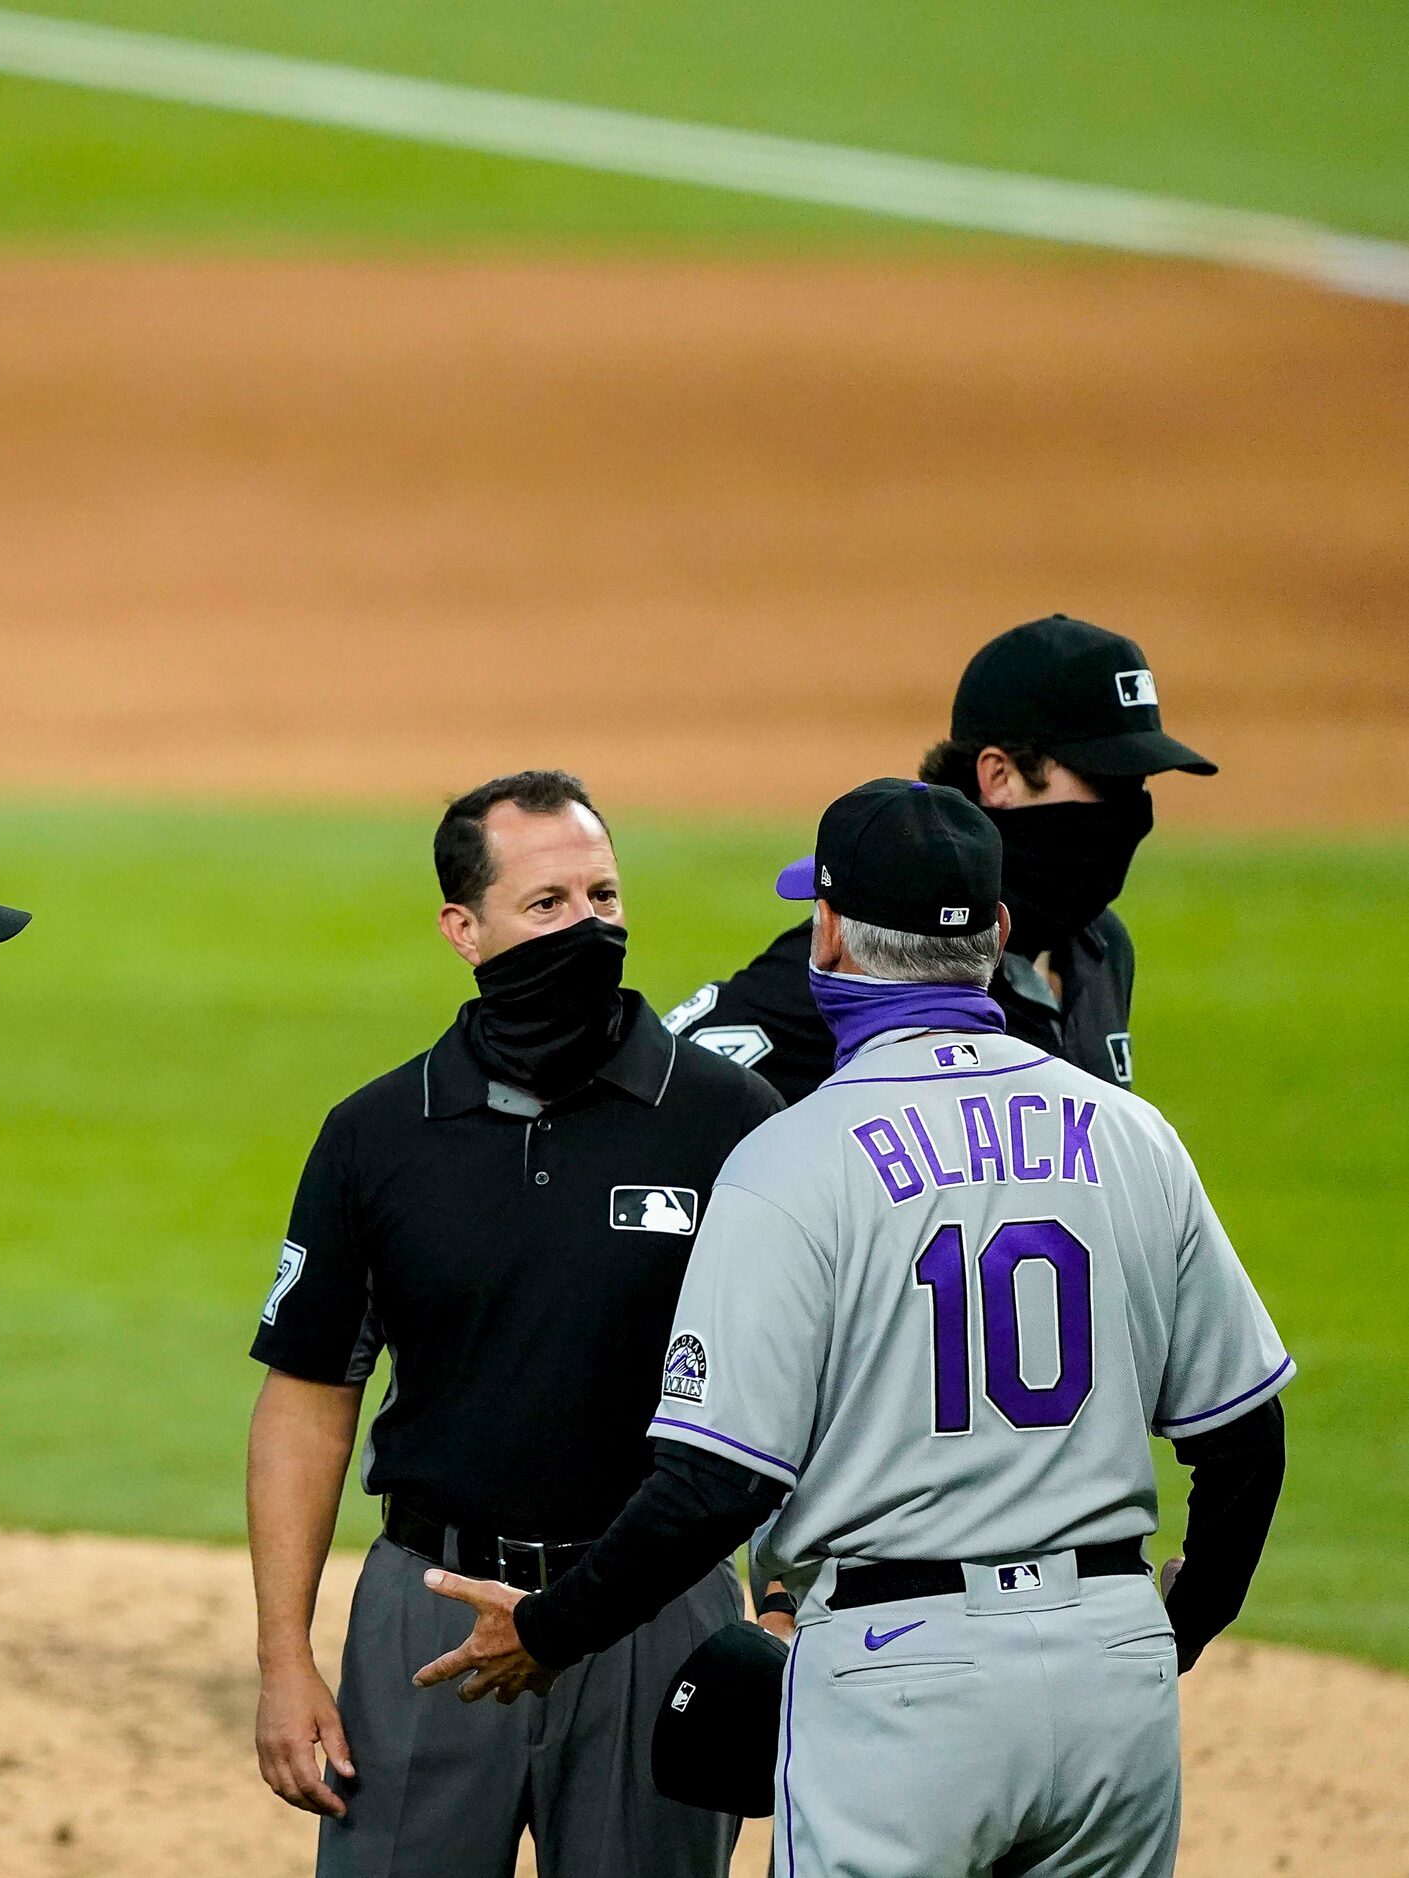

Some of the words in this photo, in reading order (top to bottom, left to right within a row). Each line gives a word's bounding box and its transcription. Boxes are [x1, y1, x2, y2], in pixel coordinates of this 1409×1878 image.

[849, 1092, 1103, 1207] BLACK
[911, 1215, 1096, 1438] 10
[663, 1372, 705, 1397] OCKIES
